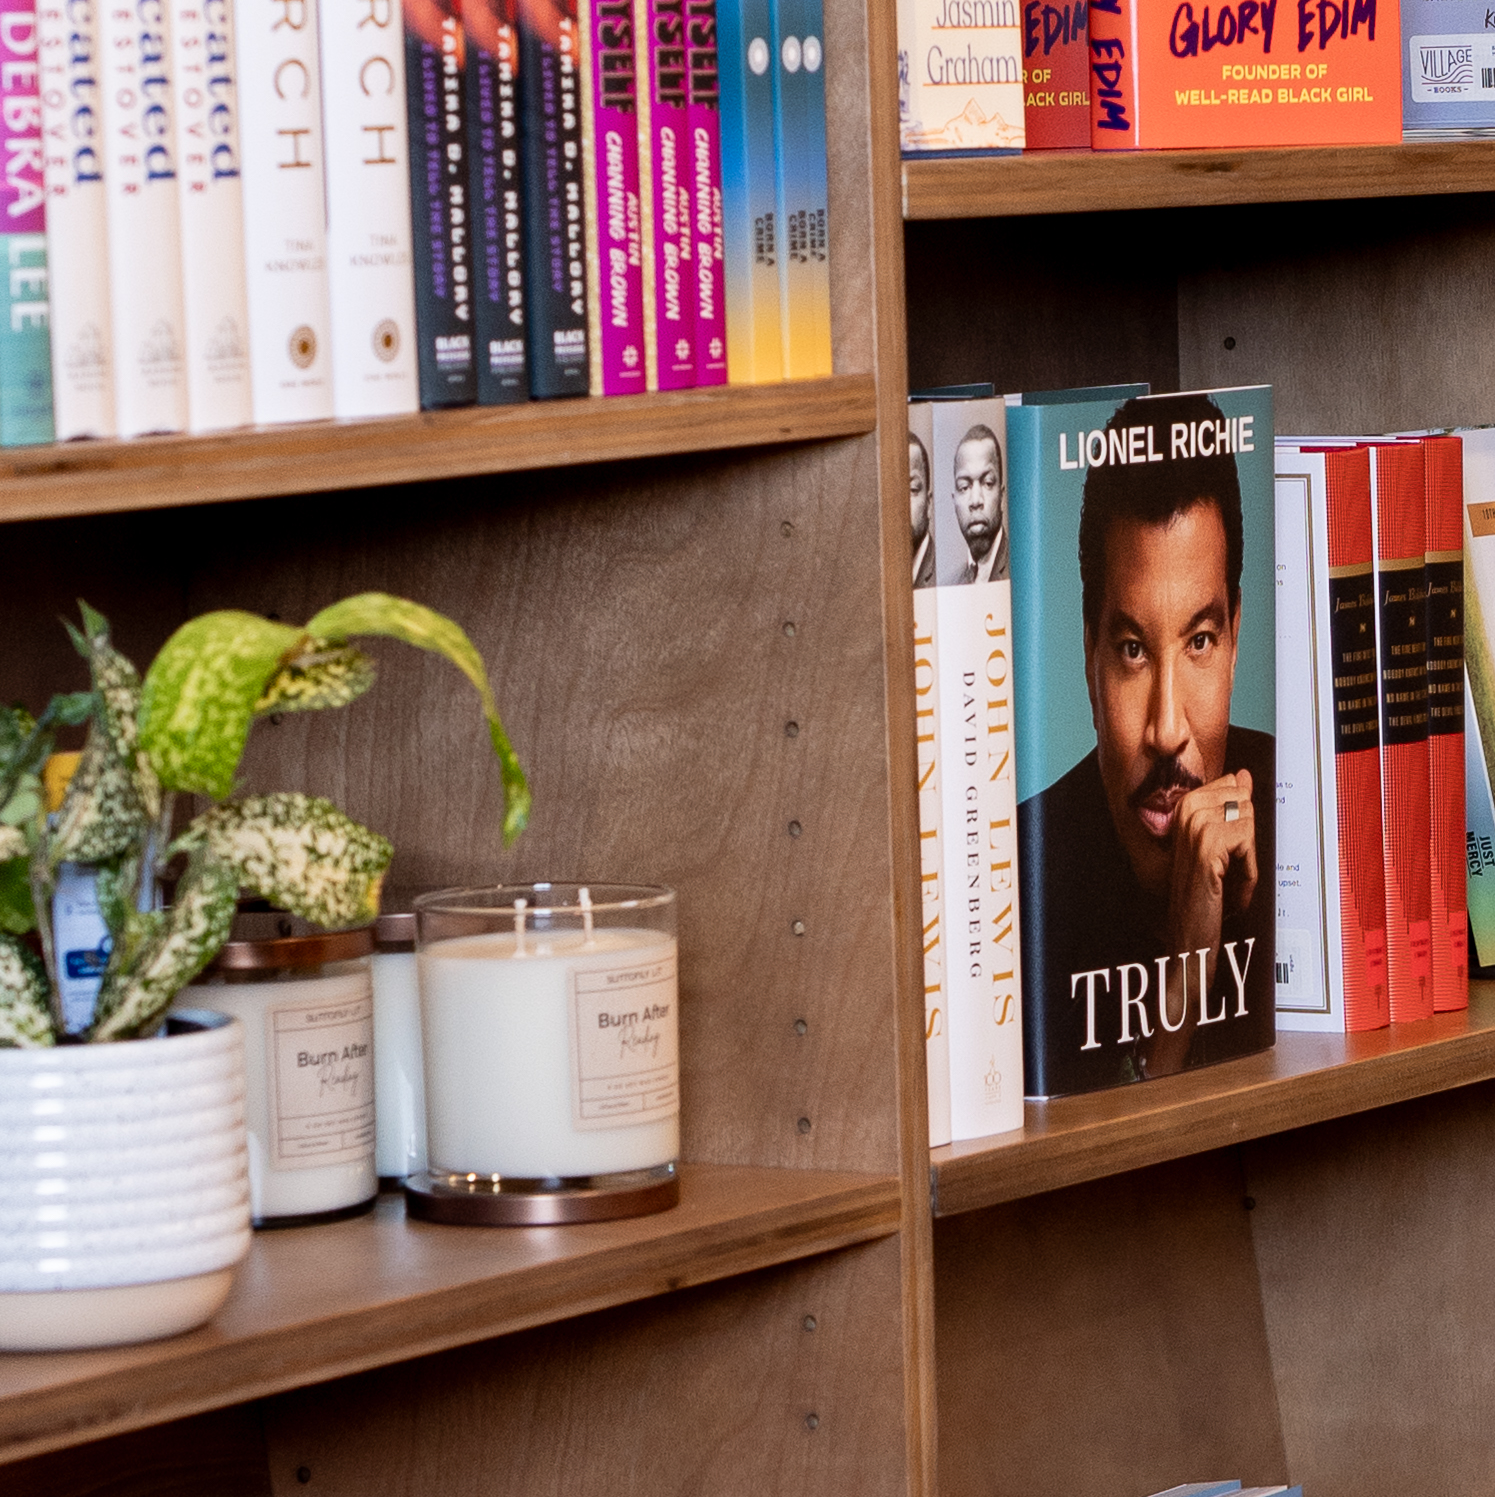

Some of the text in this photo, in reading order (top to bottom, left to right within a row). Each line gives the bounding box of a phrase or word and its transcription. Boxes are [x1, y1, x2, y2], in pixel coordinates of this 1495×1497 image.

[926, 44, 1020, 86] Graham
[1221, 62, 1328, 81] FOUNDER OF
[1420, 48, 1472, 78] VILLAGE
[1174, 86, 1373, 107] WELL-READ BLACK GIRL
[1058, 415, 1256, 471] LIONEL RICHIE
[984, 612, 1016, 1030] JOHN LEWIS
[1070, 936, 1257, 1054] TRULY
[598, 1004, 670, 1031] Burn After
